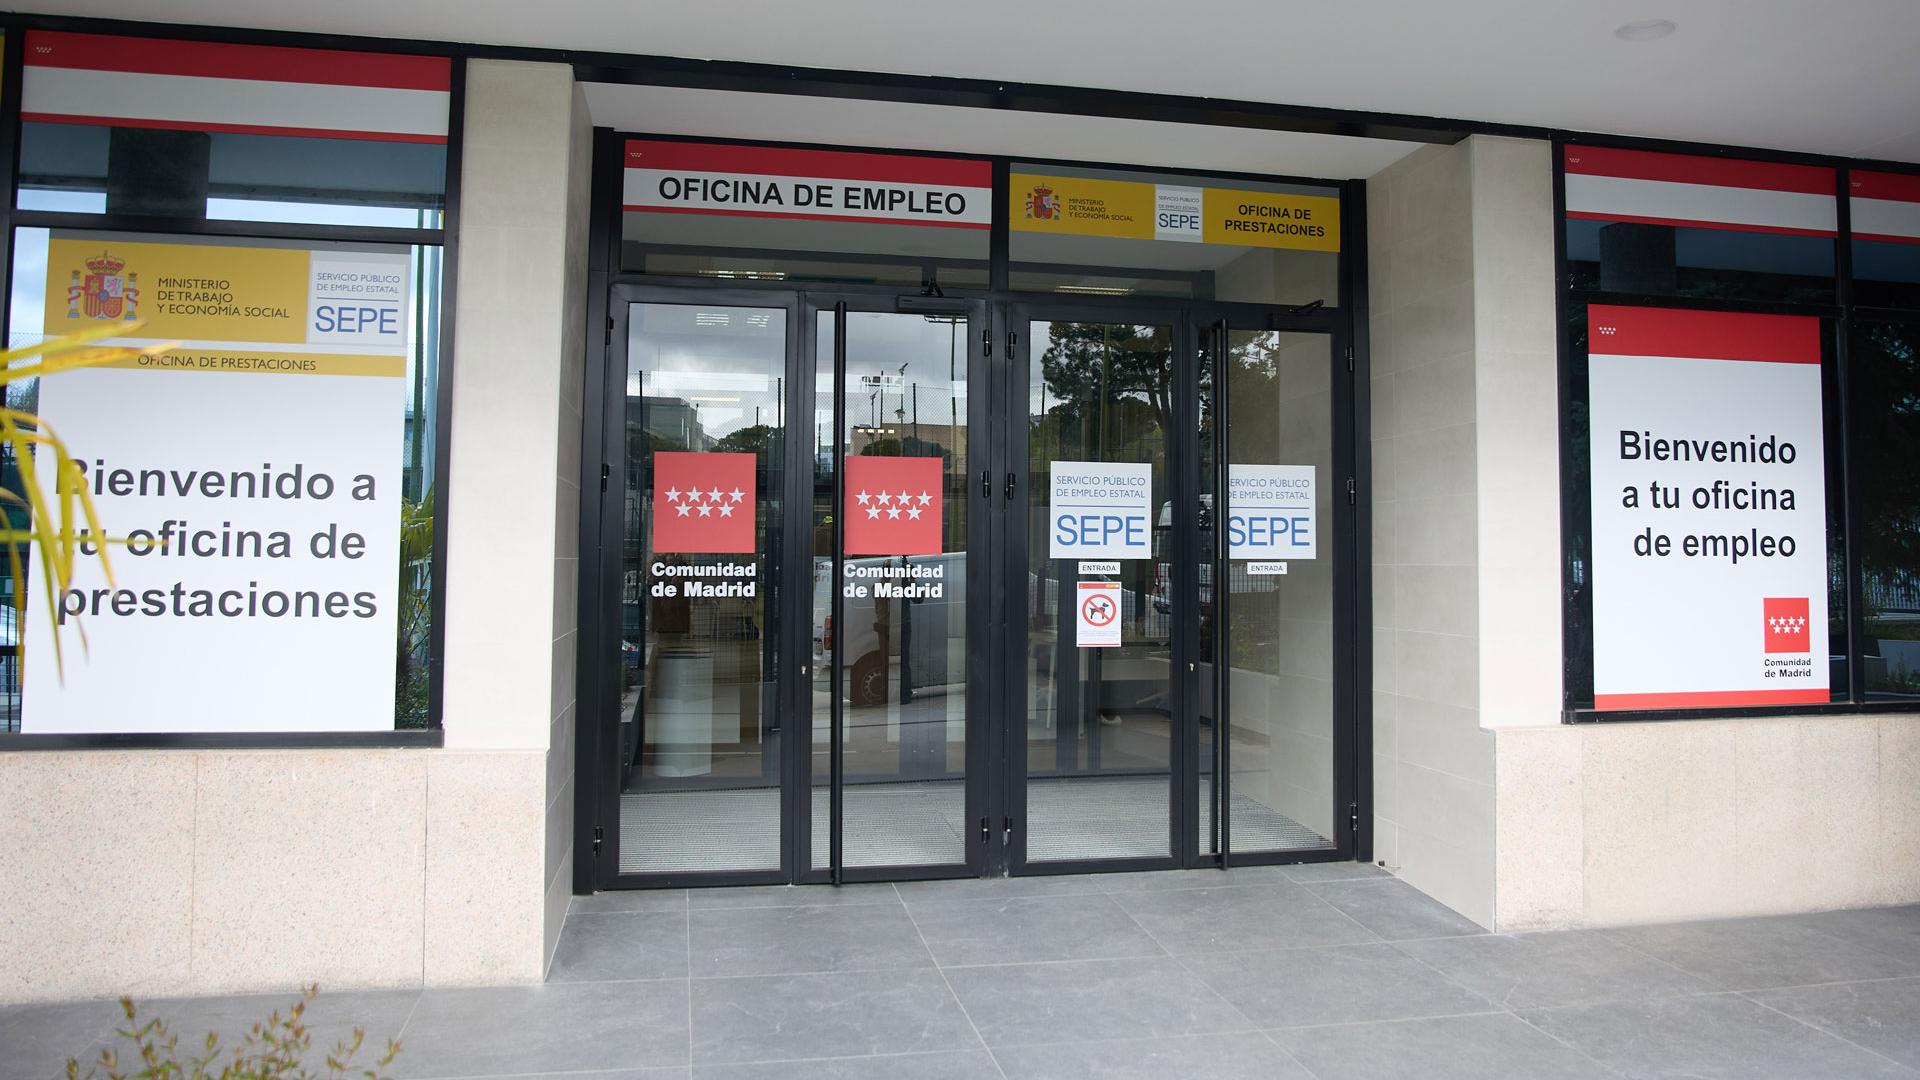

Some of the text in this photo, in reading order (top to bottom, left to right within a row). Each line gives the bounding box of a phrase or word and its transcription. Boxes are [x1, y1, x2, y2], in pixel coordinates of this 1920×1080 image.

[658, 176, 966, 215] OFICINA DE EMPLEO
[1068, 198, 1104, 206] MINISTERIO
[1110, 214, 1134, 222] SOCIAL
[1238, 204, 1311, 220] OFICINA DE
[1158, 213, 1199, 230] SEPE
[1224, 219, 1325, 237] PRESTACIONES
[158, 278, 230, 290] MINISTERIO
[317, 272, 401, 284] SERVICIO PÚBLICO
[316, 283, 400, 294] DE EMPLEO ESTATAL
[157, 290, 233, 305] DE TRABAJO
[157, 303, 290, 318] Y ECONOMÍA SOCIAL
[315, 305, 398, 334] SEPE
[199, 356, 217, 368] DE
[221, 357, 317, 371] PRESTACIONES
[1620, 430, 1797, 465] Bienvenido
[352, 473, 376, 500] a
[1056, 473, 1146, 487] SERVICIO PÚBLICO
[1229, 477, 1310, 488] ERVICIO PÚBLICO
[1056, 488, 1145, 499] DE EMPLEO ESTATAL
[1239, 490, 1273, 500] EMPLEO
[1275, 490, 1310, 500] ESTATAL
[1622, 480, 1796, 511] a tu oficina
[1056, 514, 1146, 546] SEPE
[1229, 515, 1310, 547] SEPE
[126, 520, 291, 558] oficina
[310, 523, 366, 559] de
[1634, 528, 1796, 564] de empleo
[651, 562, 756, 577] Comunidad
[843, 564, 944, 578] Comunidad
[1082, 564, 1117, 572] ENTRADA
[651, 582, 756, 597] de Madrid
[843, 582, 943, 598] de Madrid
[57, 581, 377, 625] prestaciones
[1764, 657, 1812, 668] Comunidad
[1764, 668, 1812, 678] de Madrid
